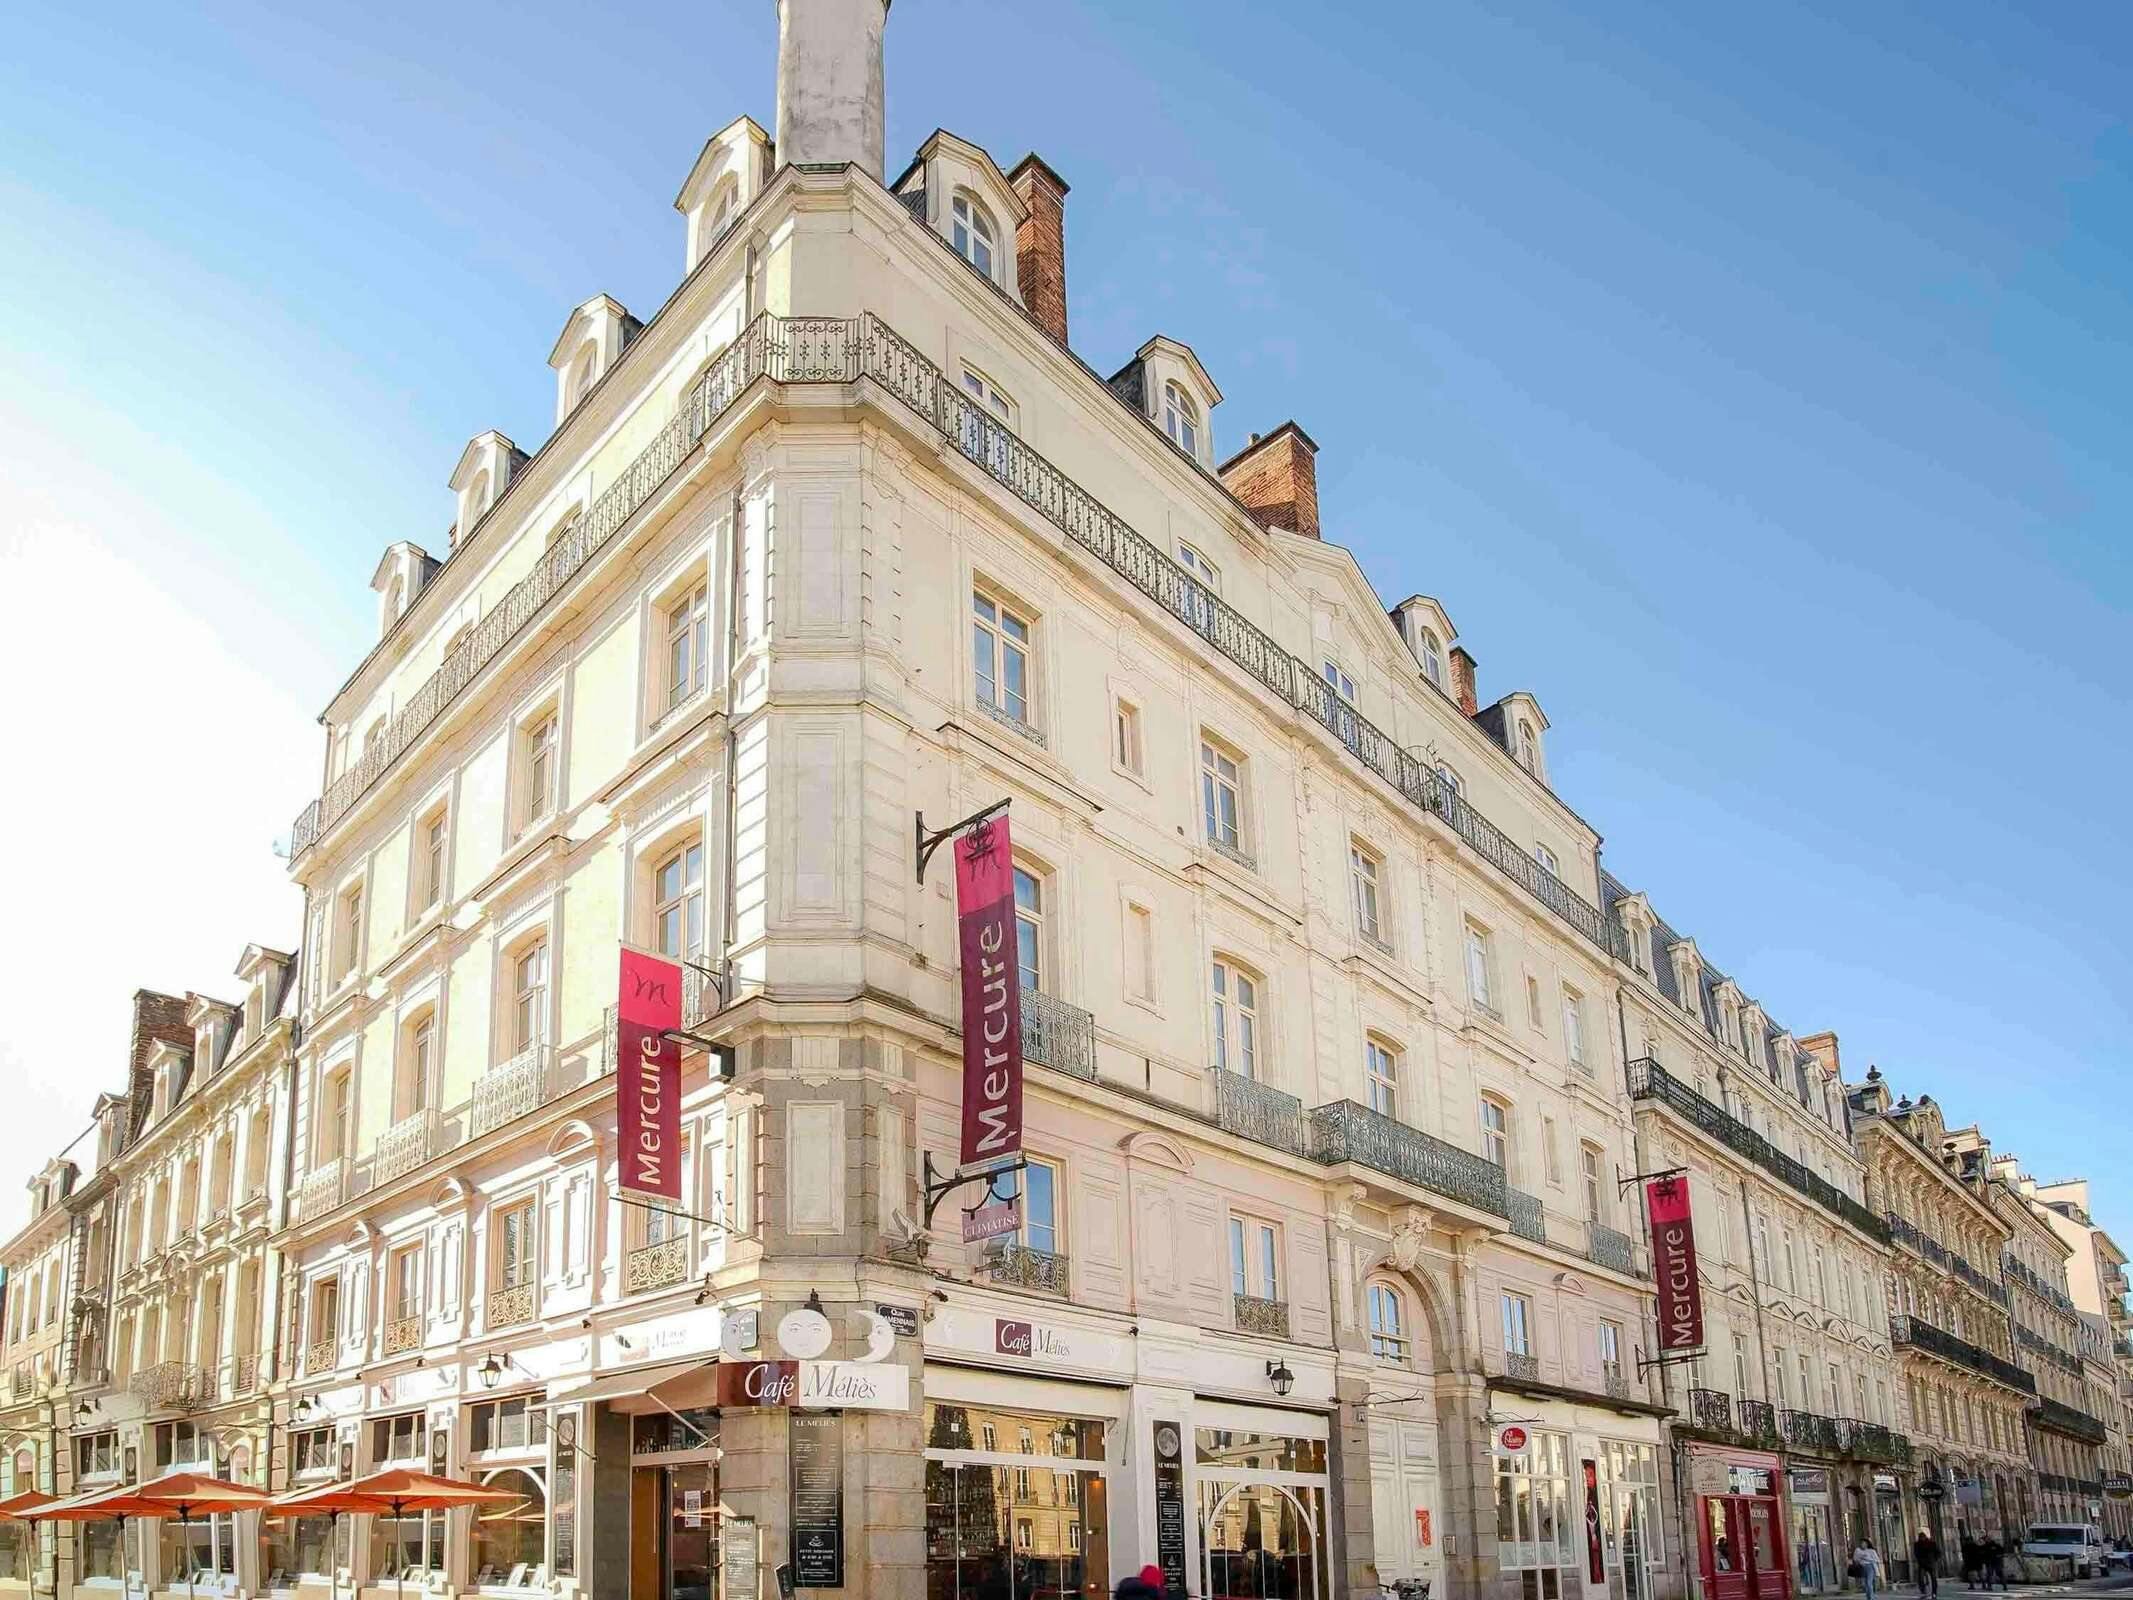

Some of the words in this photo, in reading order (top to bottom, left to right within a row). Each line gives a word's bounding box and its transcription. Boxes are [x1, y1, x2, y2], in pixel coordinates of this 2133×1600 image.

[976, 920, 1010, 1153] Mercure
[637, 1035, 662, 1186] Mercure
[1000, 1323, 1030, 1354] Café
[1665, 1228, 1693, 1346] Mercure
[744, 1363, 795, 1404] Café
[803, 1364, 877, 1400] Méliès
